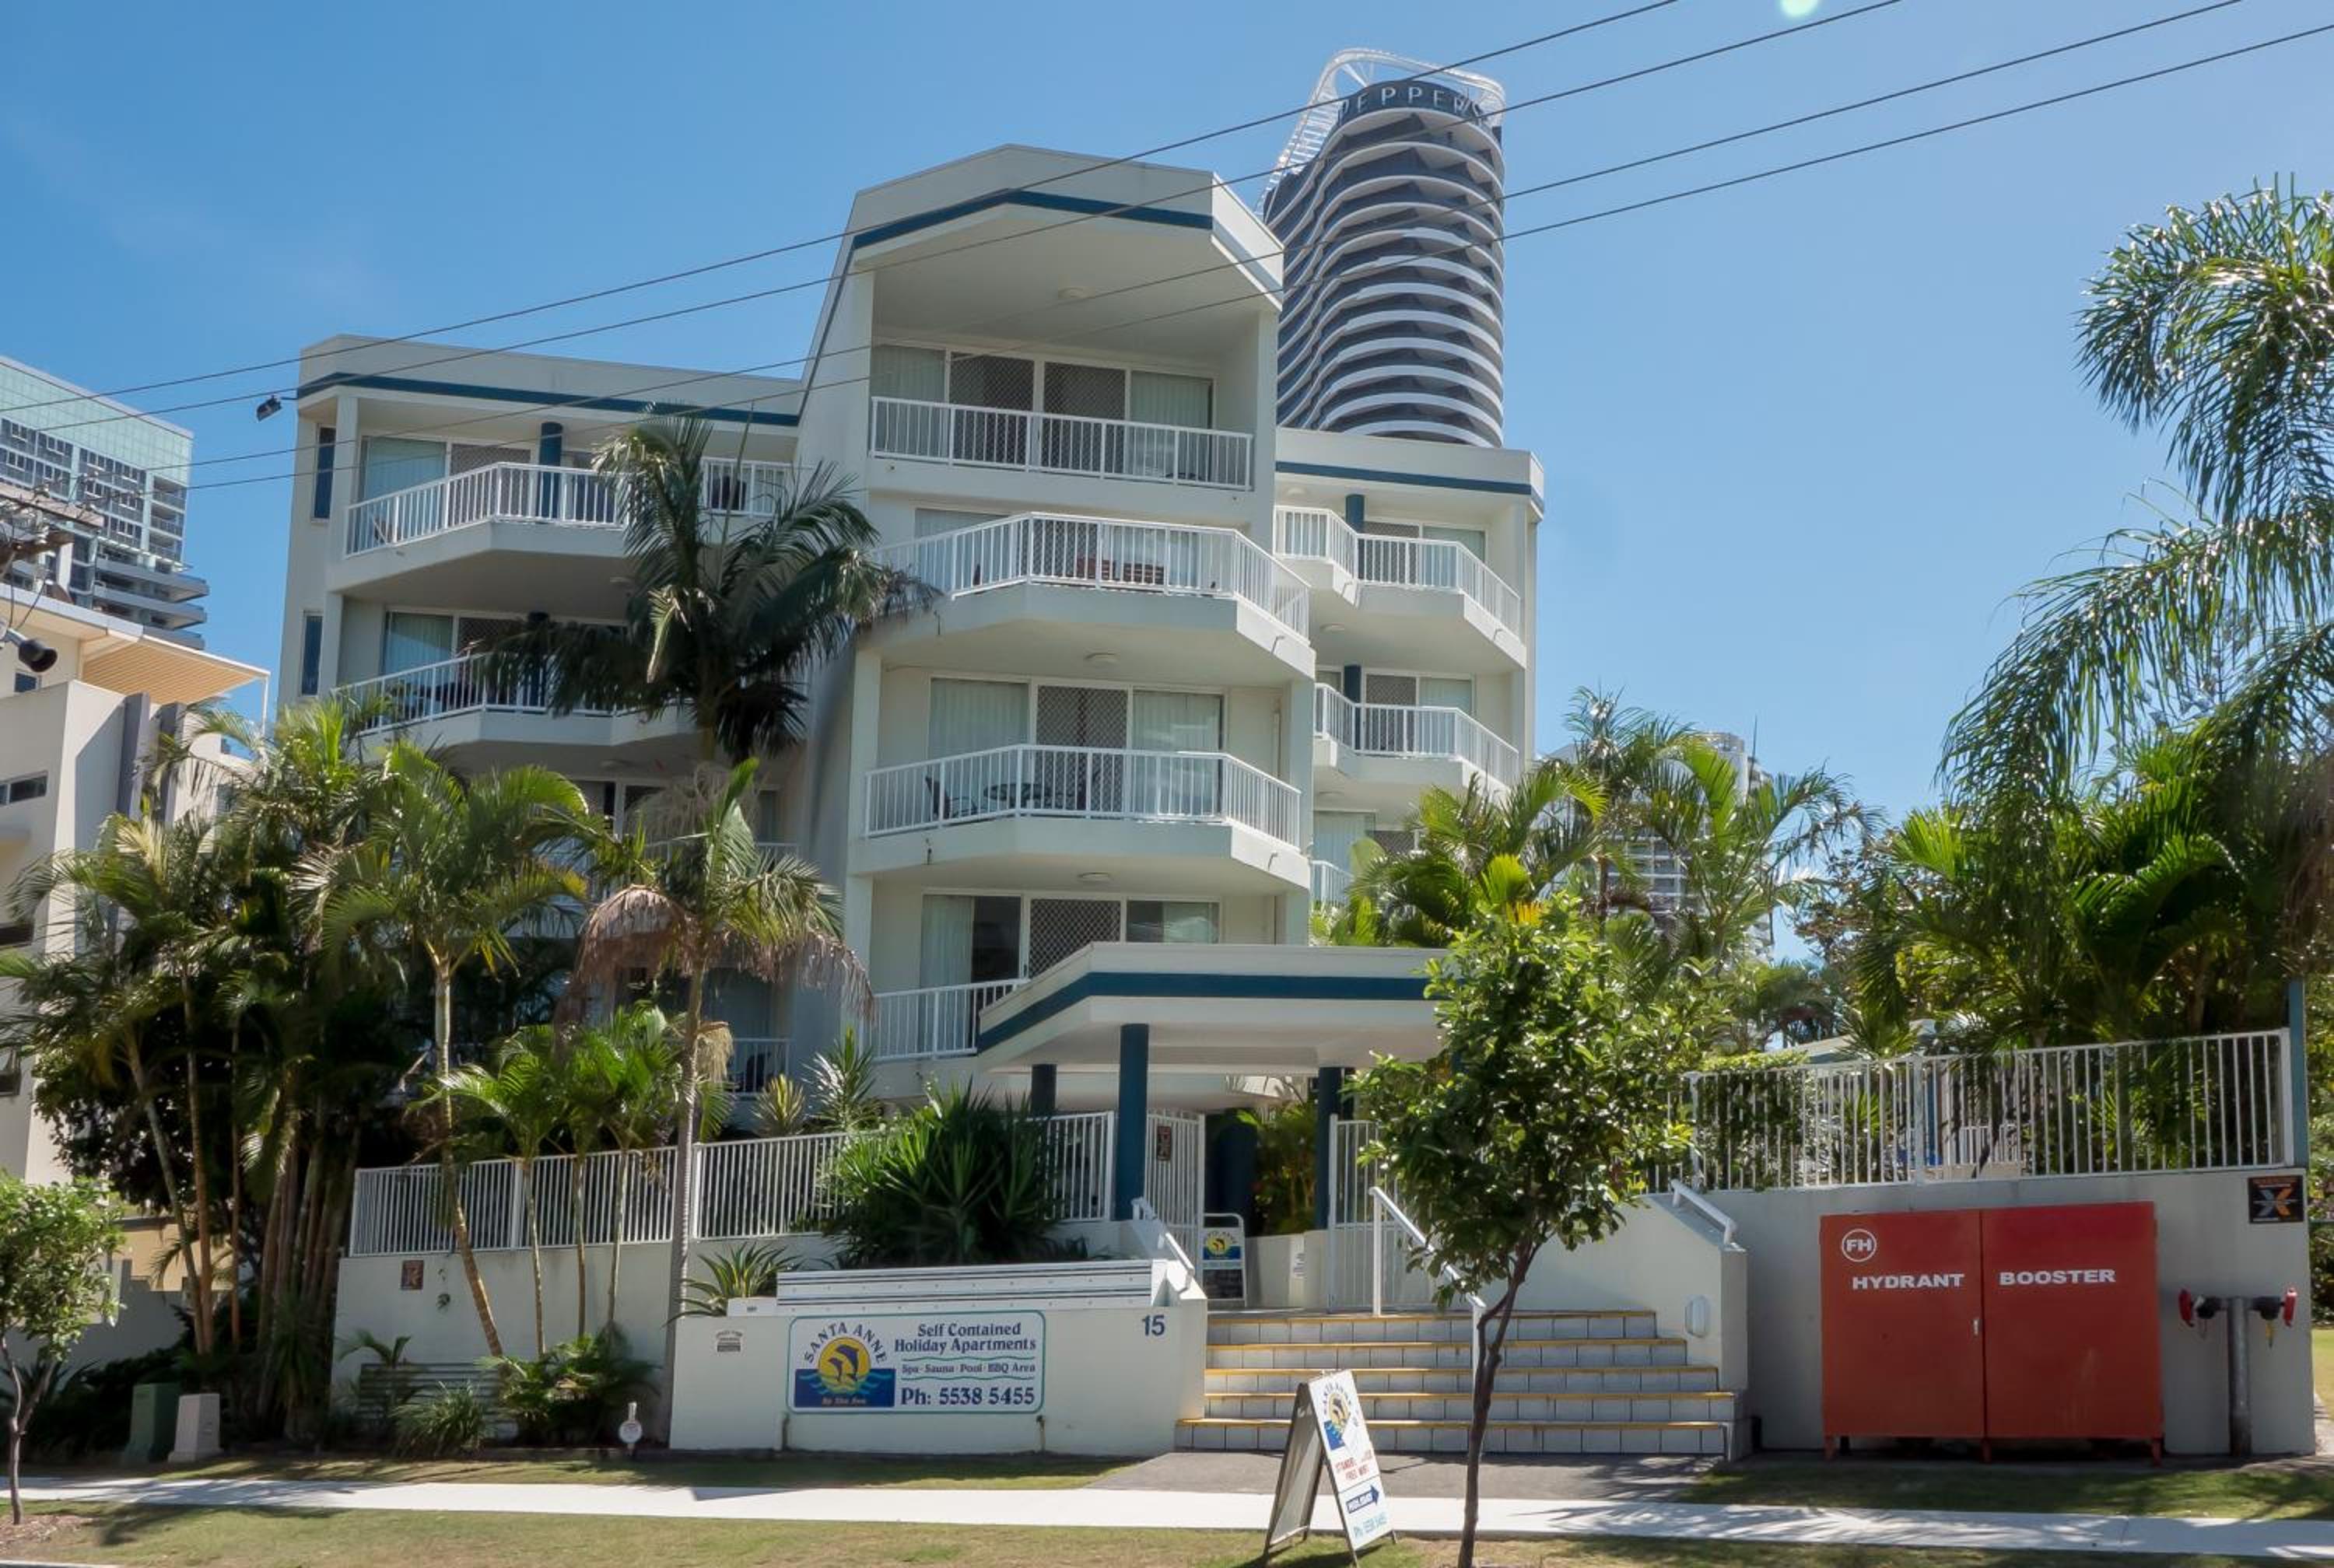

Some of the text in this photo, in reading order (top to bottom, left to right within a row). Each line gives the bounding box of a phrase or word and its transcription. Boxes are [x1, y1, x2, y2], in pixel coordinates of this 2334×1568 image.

[1845, 1238, 1873, 1253] FH
[1852, 1269, 2116, 1290] HYDRANT BOOSTER
[917, 1322, 1022, 1337] Self Contained
[1141, 1314, 1165, 1337] 15
[804, 1321, 888, 1363] SANTA ANNE
[894, 1337, 1037, 1355] Holiday Apartments
[902, 1361, 1036, 1374] Spa Sauna Pool BBQ Area
[900, 1386, 1036, 1405] Ph: 5538 5455
